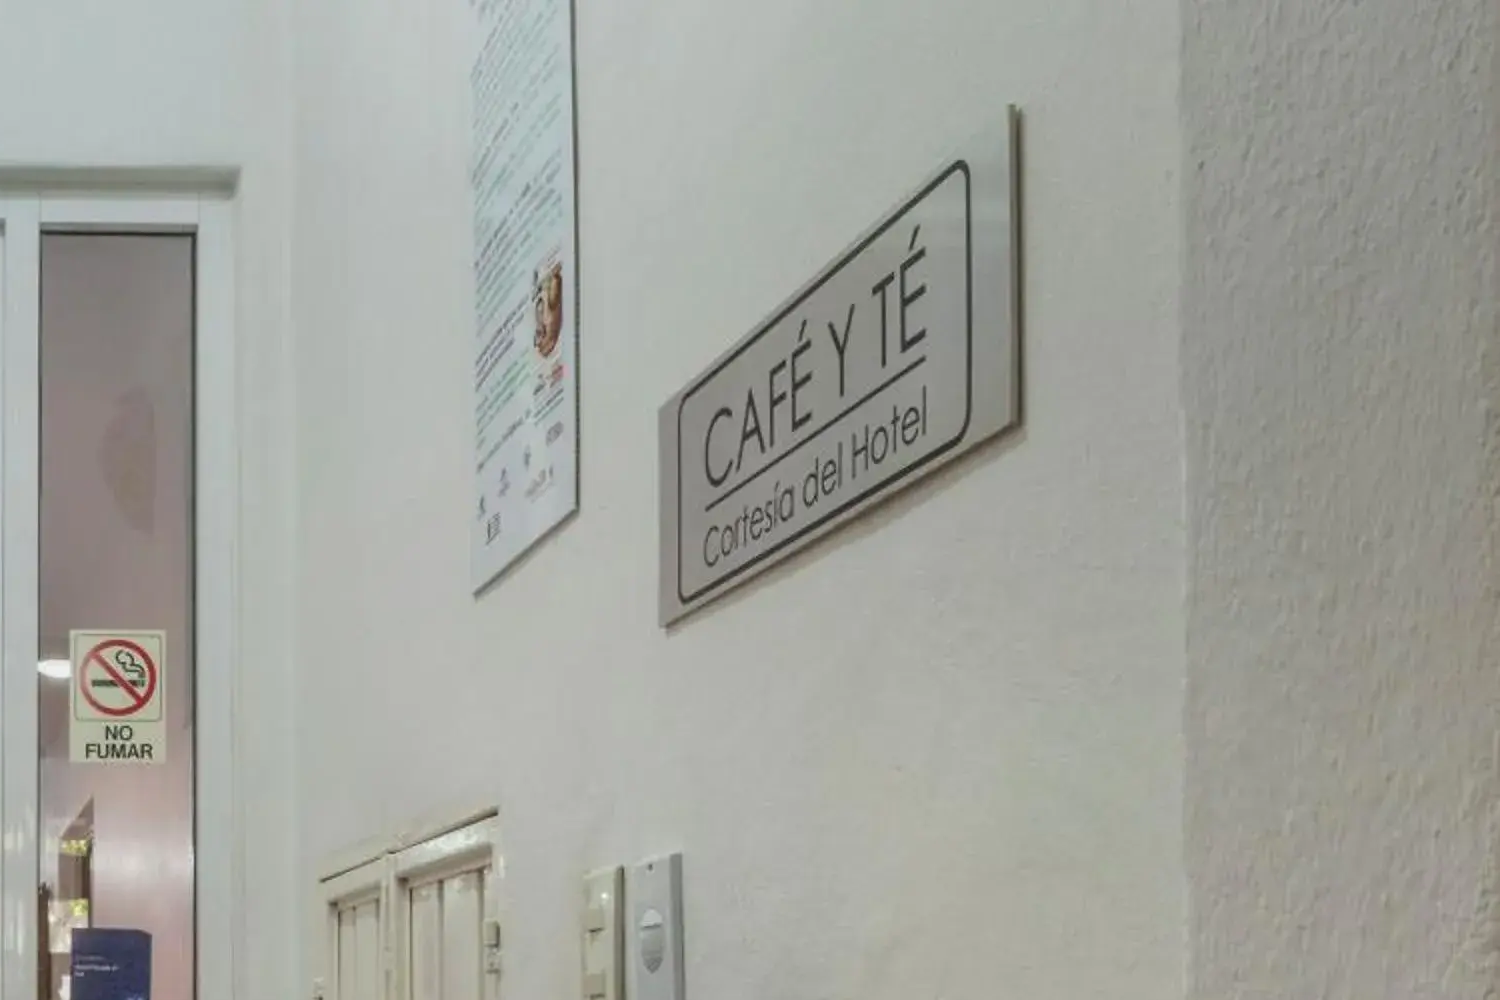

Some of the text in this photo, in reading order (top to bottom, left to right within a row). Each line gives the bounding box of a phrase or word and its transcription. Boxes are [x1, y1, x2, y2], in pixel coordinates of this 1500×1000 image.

[704, 319, 813, 488] CAFÉ
[828, 303, 855, 398] Y
[871, 224, 927, 369] TÉ
[703, 384, 927, 568] Cortesía del Hotel
[85, 743, 154, 760] FUMAR
[104, 725, 134, 741] NO
